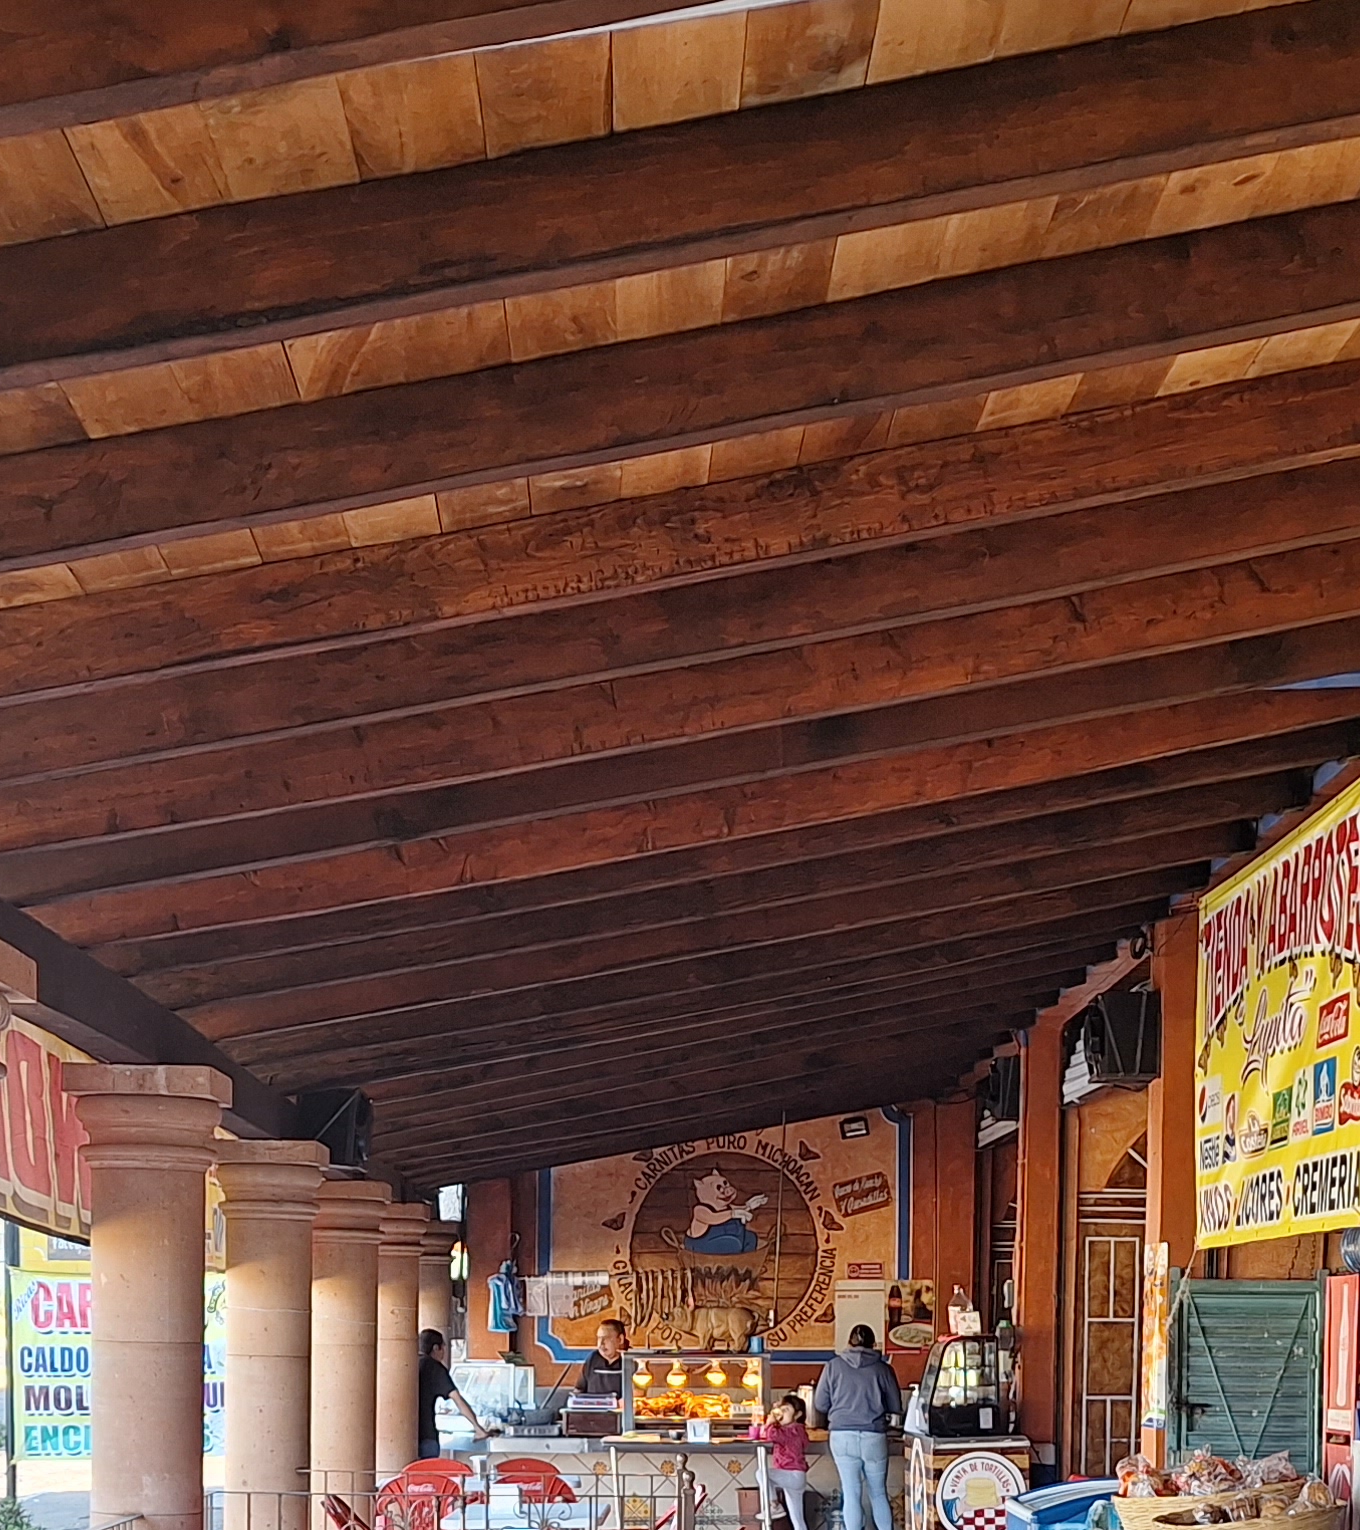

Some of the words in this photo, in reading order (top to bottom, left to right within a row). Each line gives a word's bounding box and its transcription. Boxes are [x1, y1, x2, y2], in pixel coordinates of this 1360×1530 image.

[634, 1140, 696, 1190] CARNITAS
[705, 1133, 748, 1151] PURO
[755, 1138, 821, 1203] MICHOACAN
[1235, 1168, 1283, 1228] LICORES
[1292, 1150, 1360, 1219] CREMERIA
[767, 1327, 788, 1347] SU
[789, 1246, 838, 1334] PREFERENCIA
[950, 1465, 969, 1489] VENTA
[970, 1462, 978, 1472] DE
[980, 1461, 1011, 1491] TORTILLAS
